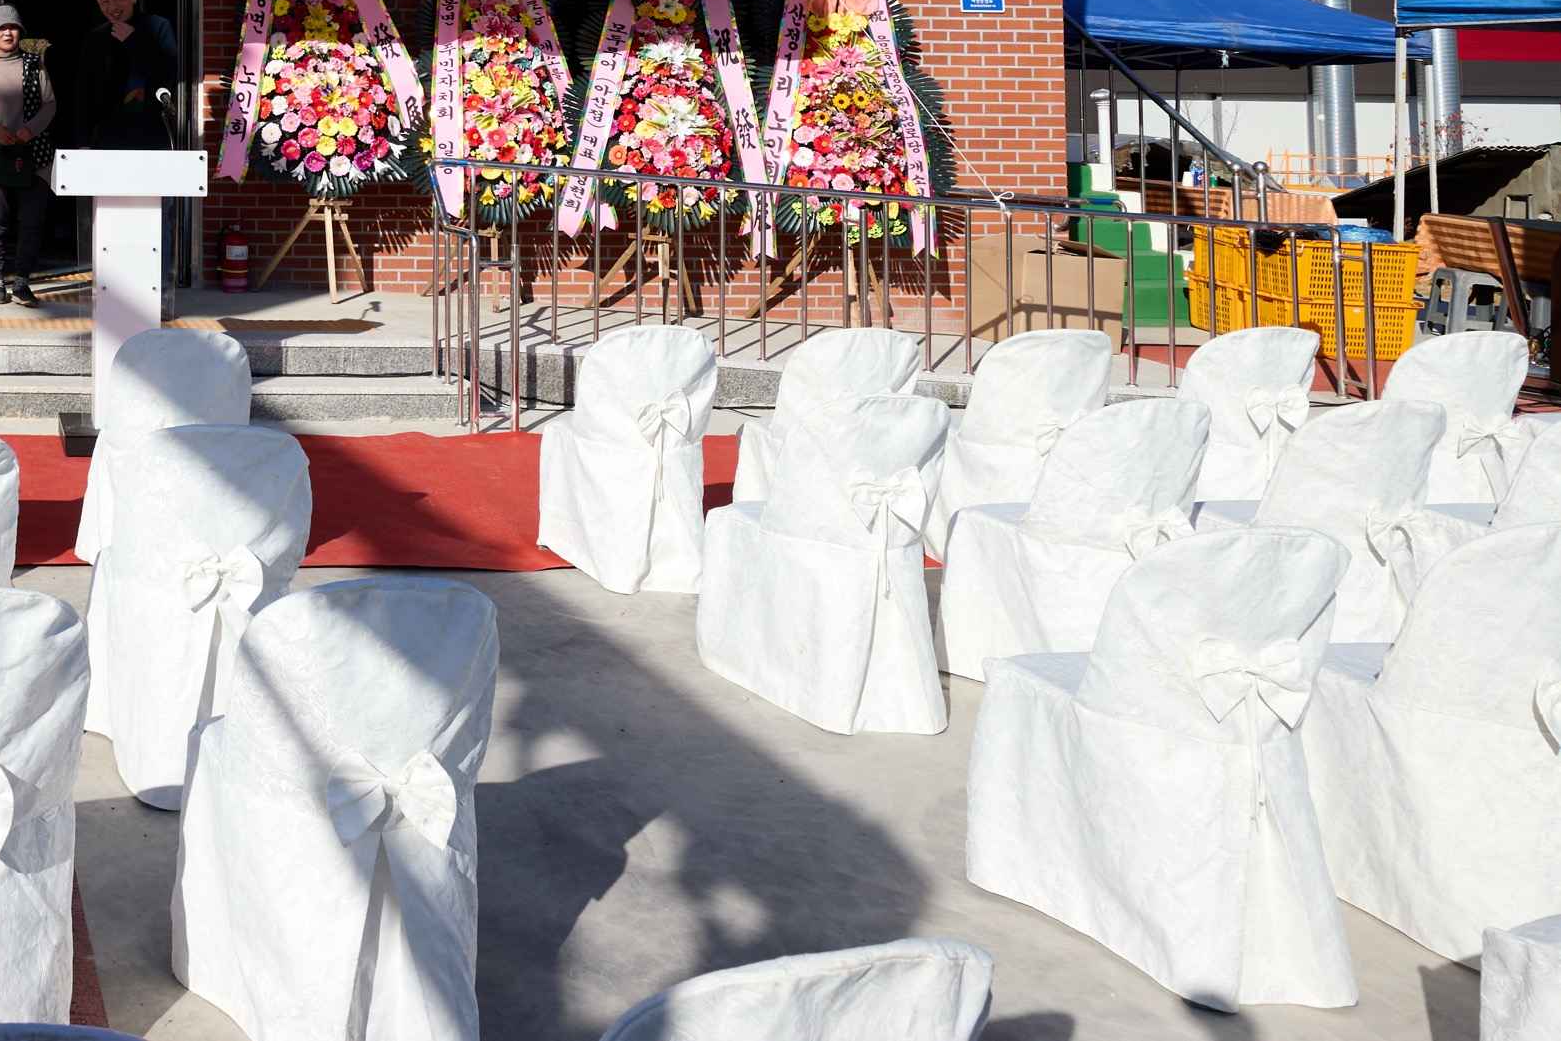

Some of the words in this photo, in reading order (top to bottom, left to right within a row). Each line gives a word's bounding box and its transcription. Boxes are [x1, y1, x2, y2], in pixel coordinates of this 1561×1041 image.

[437, 42, 457, 121] 주민자치회
[775, 2, 806, 99] 산정1리
[229, 64, 257, 143] 노인회
